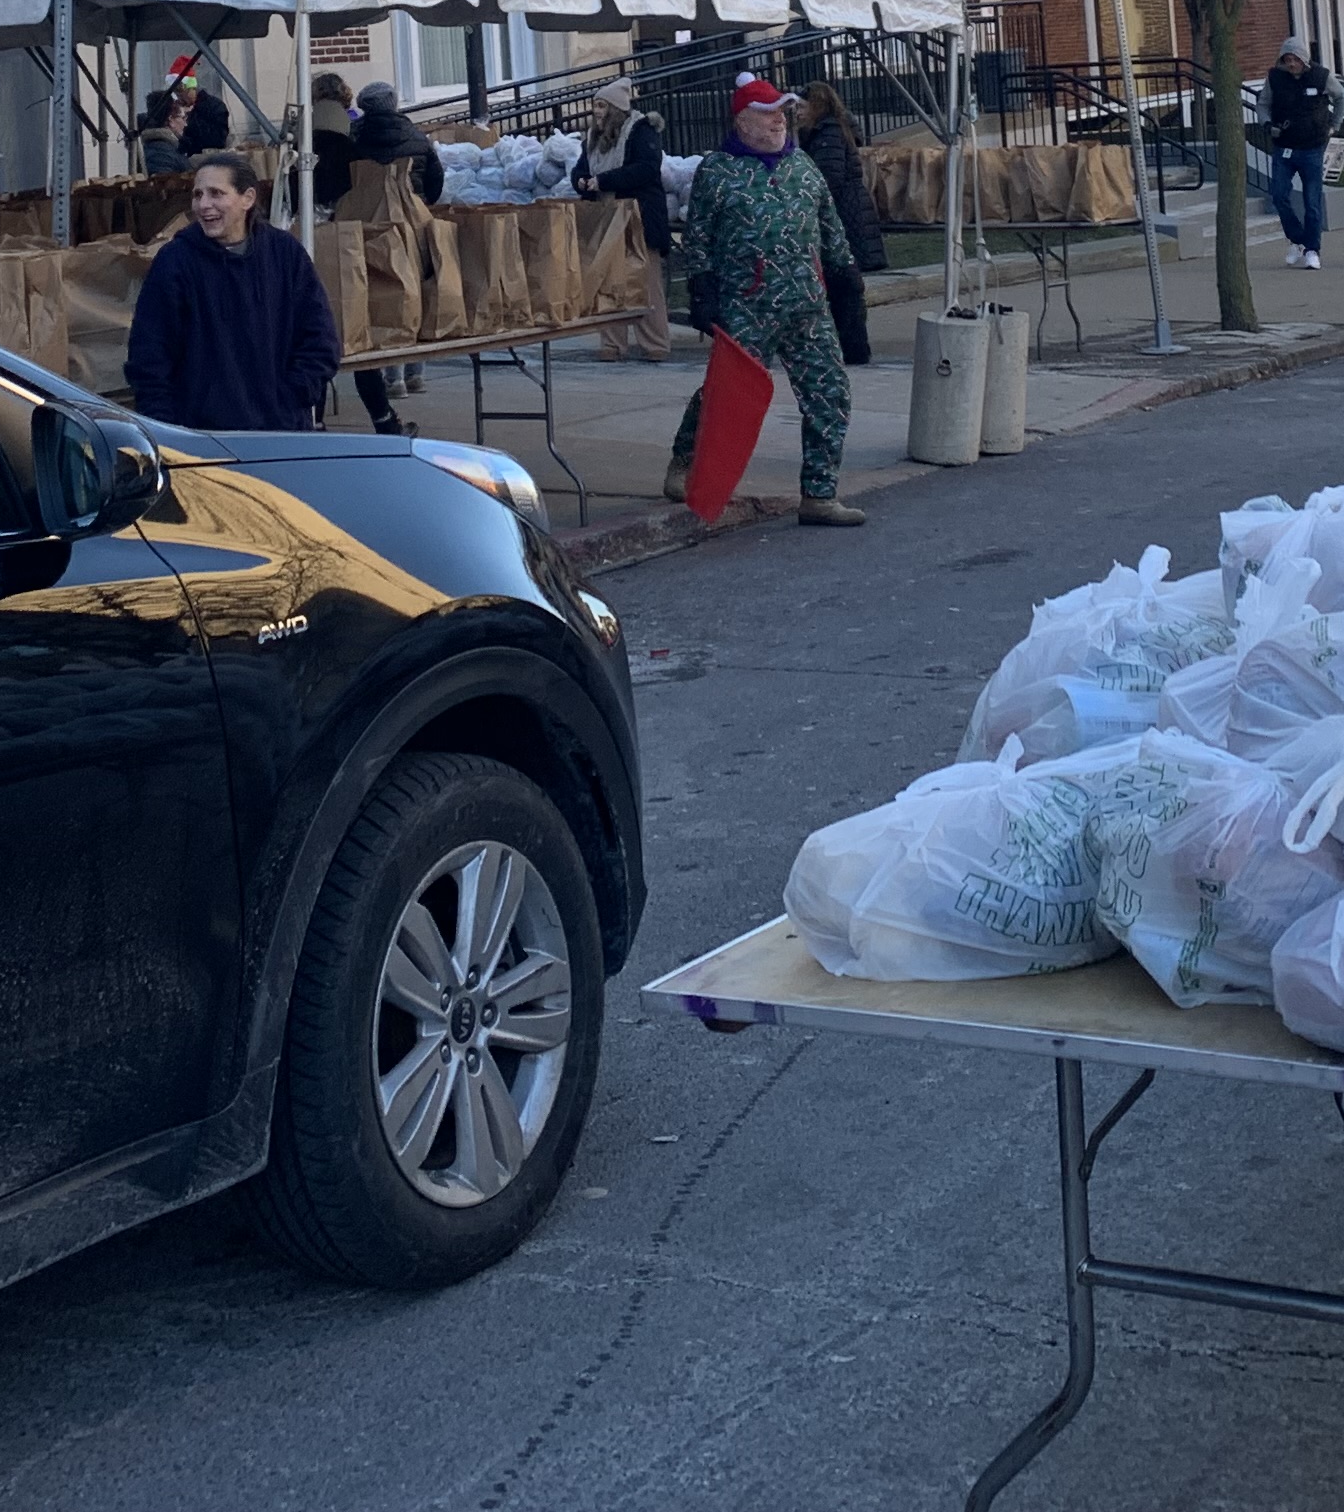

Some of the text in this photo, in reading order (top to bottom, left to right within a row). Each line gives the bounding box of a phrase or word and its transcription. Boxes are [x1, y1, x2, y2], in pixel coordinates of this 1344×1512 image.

[257, 614, 309, 645] AWD
[954, 872, 1097, 947] THANK
[459, 1002, 471, 1040] KIA
